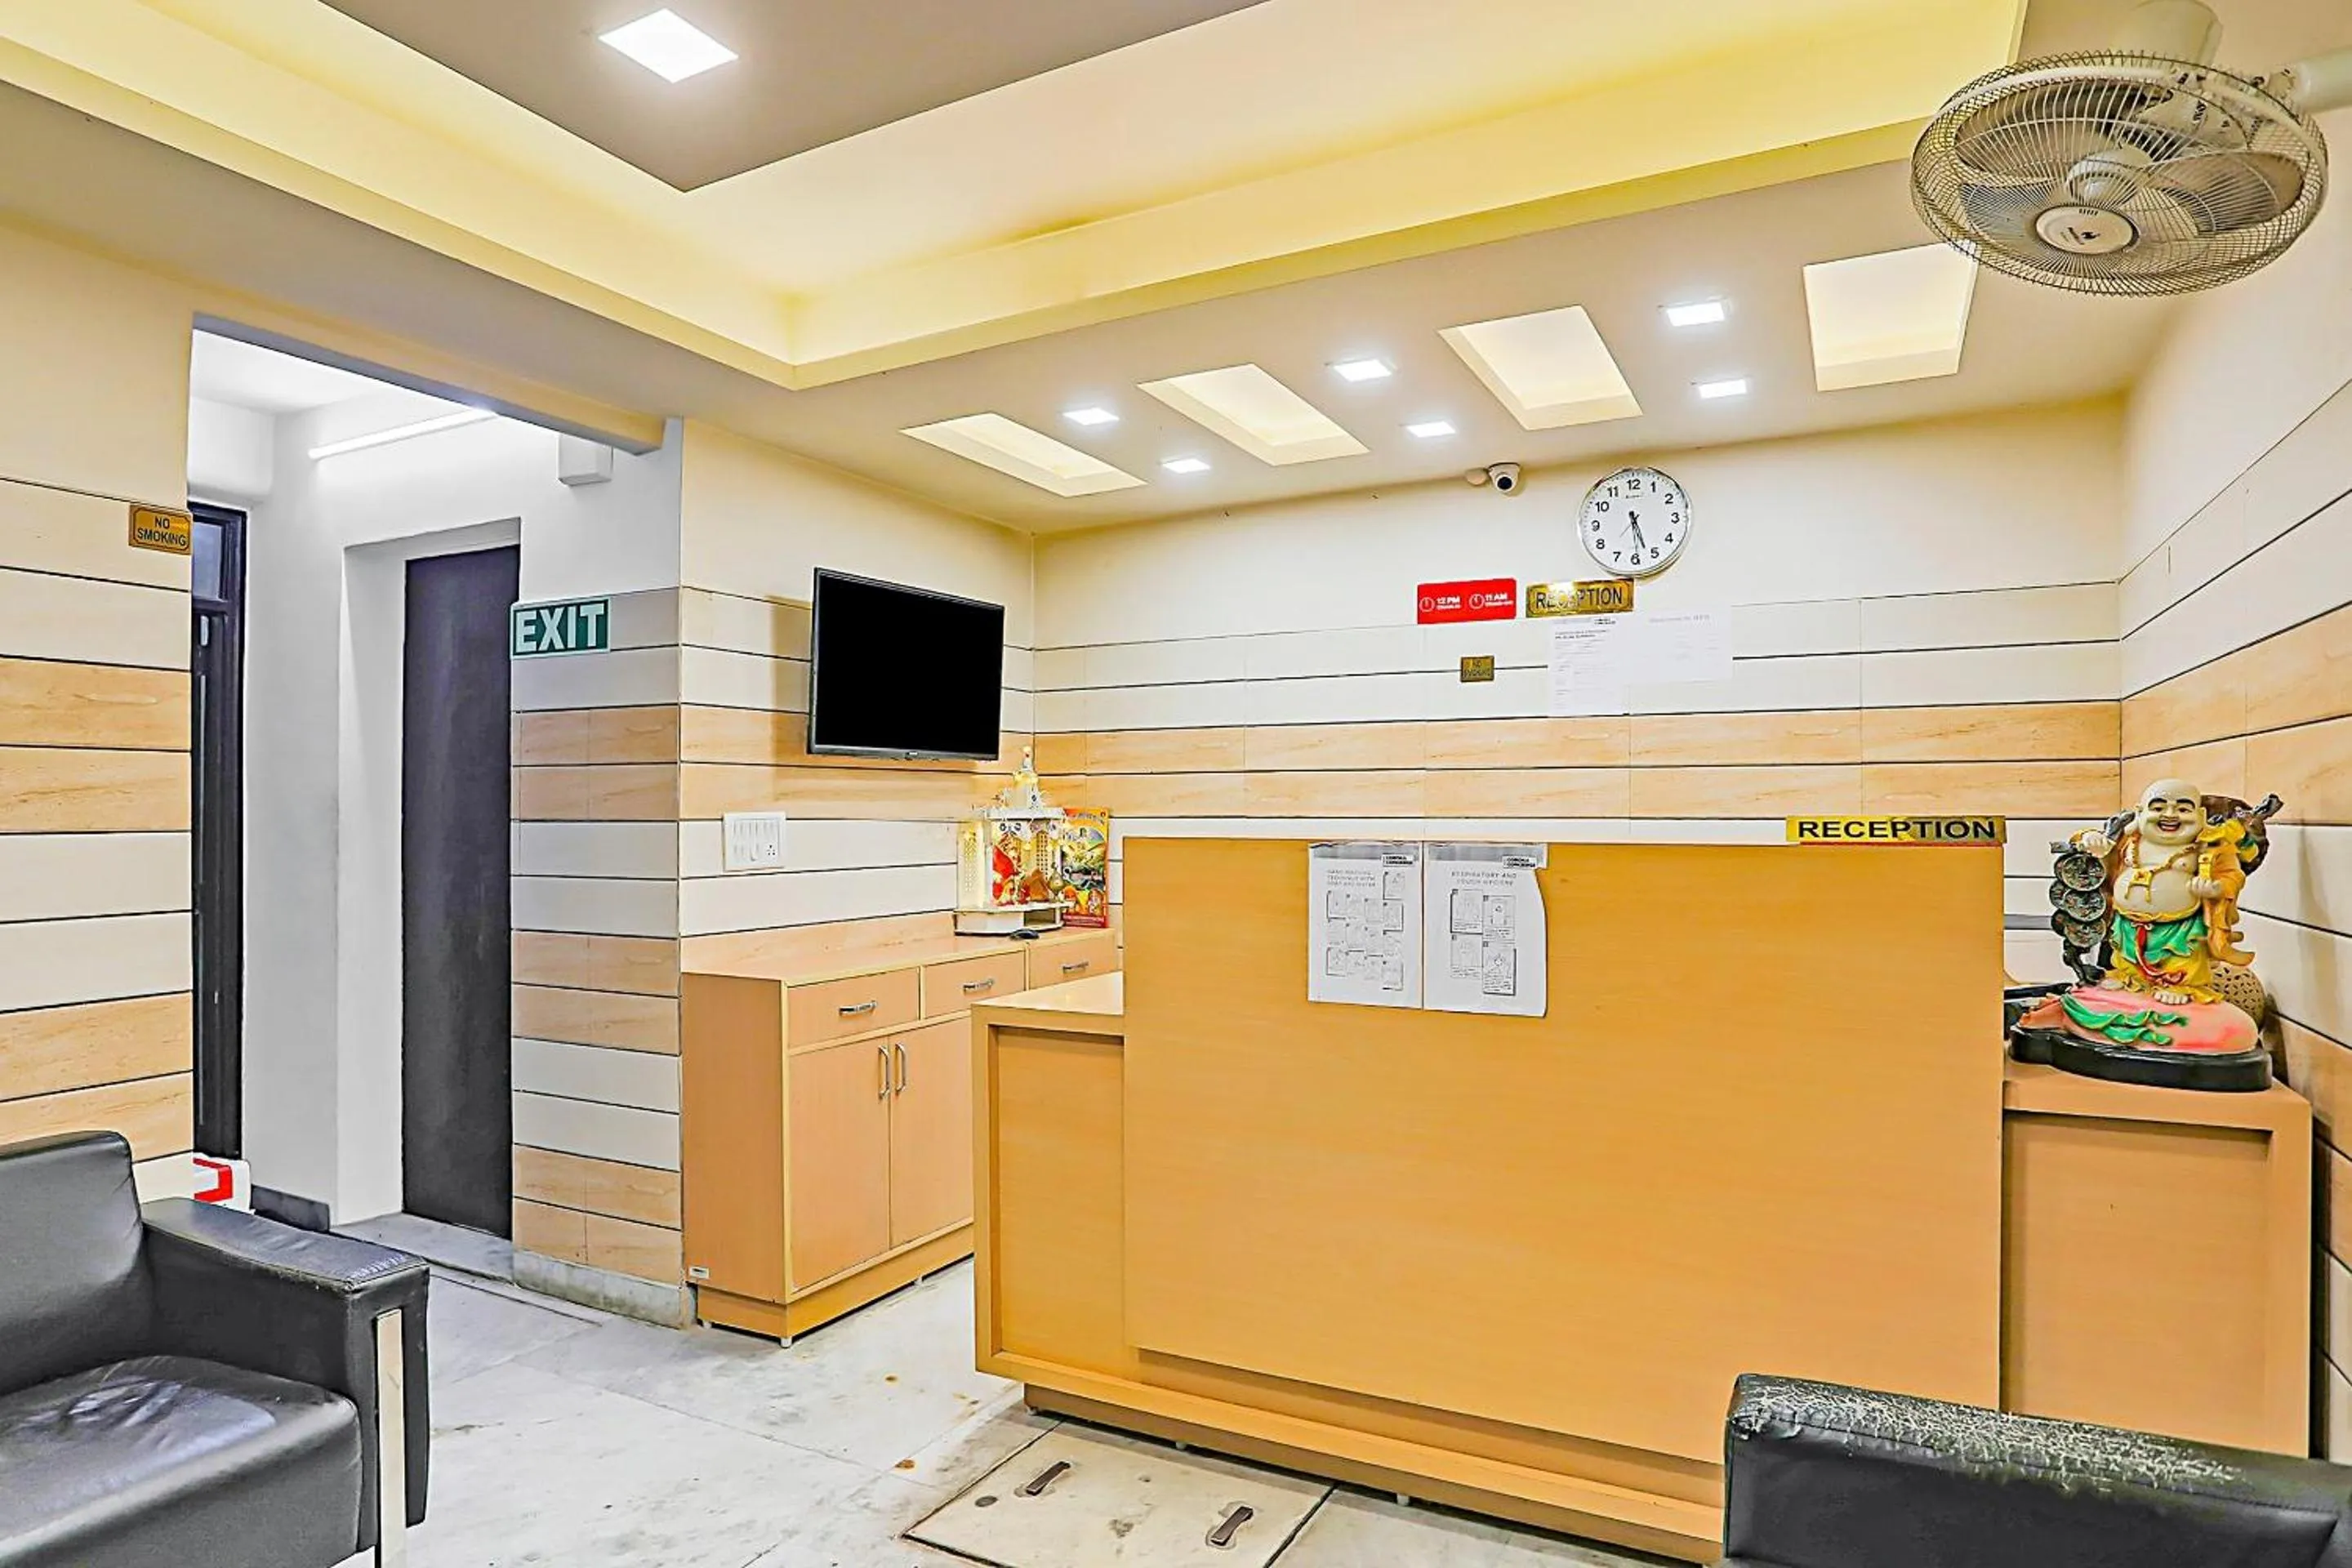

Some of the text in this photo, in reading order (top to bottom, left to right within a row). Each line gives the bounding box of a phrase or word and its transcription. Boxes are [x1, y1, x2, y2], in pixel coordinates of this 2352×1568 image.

[1626, 479, 1641, 490] 12
[1650, 481, 1656, 492] 1
[1607, 486, 1619, 497] 11
[1664, 493, 1673, 504] 2
[1595, 501, 1610, 512] 10
[154, 515, 170, 529] NO
[1671, 512, 1680, 523] 3
[1592, 520, 1600, 532] 9
[137, 527, 186, 546] SMOKING
[1664, 532, 1673, 543] 4
[1596, 539, 1605, 550] 8
[1613, 551, 1621, 562] 7
[1650, 547, 1659, 559] 5
[1630, 553, 1640, 565] 6
[1446, 595, 1460, 604] PM
[1494, 592, 1508, 600] AM
[515, 603, 604, 653] EXIT
[1798, 820, 1996, 839] RECEPTION
